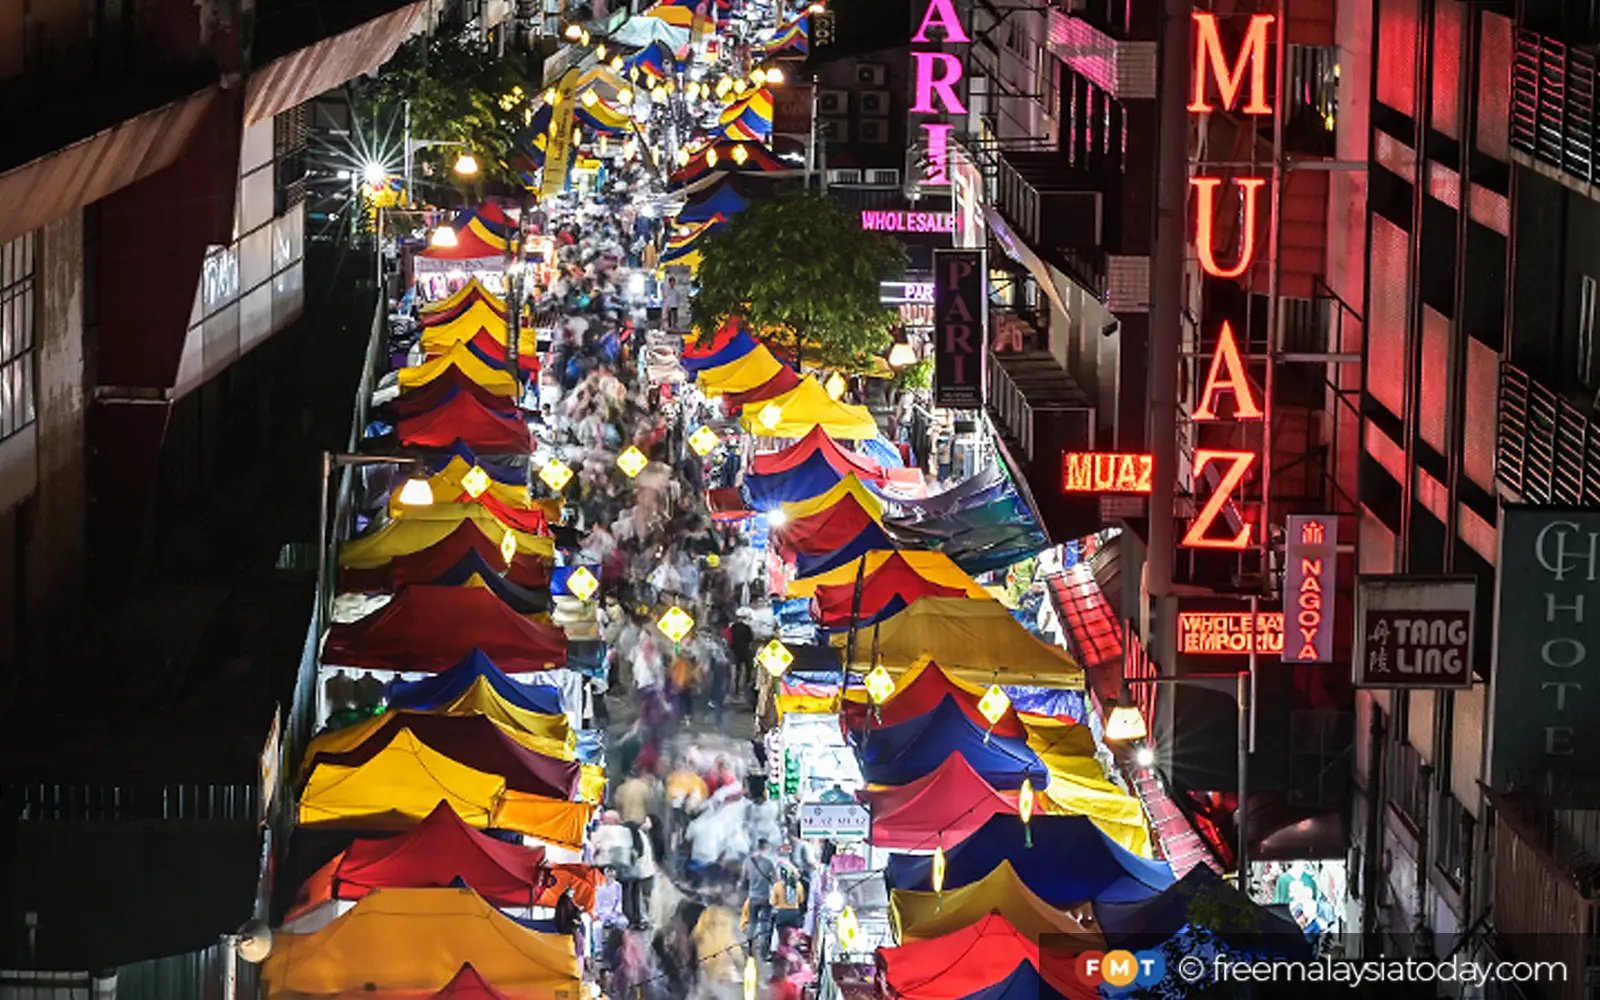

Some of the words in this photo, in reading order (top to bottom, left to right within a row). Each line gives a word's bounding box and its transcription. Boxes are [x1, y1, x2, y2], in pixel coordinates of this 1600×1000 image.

[1181, 13, 1275, 549] MUAZ
[945, 261, 974, 384] PARI
[1065, 452, 1152, 491] MUAZ
[1298, 558, 1323, 661] NAGOYA
[1394, 619, 1467, 645] TANG
[1396, 648, 1463, 674] LING
